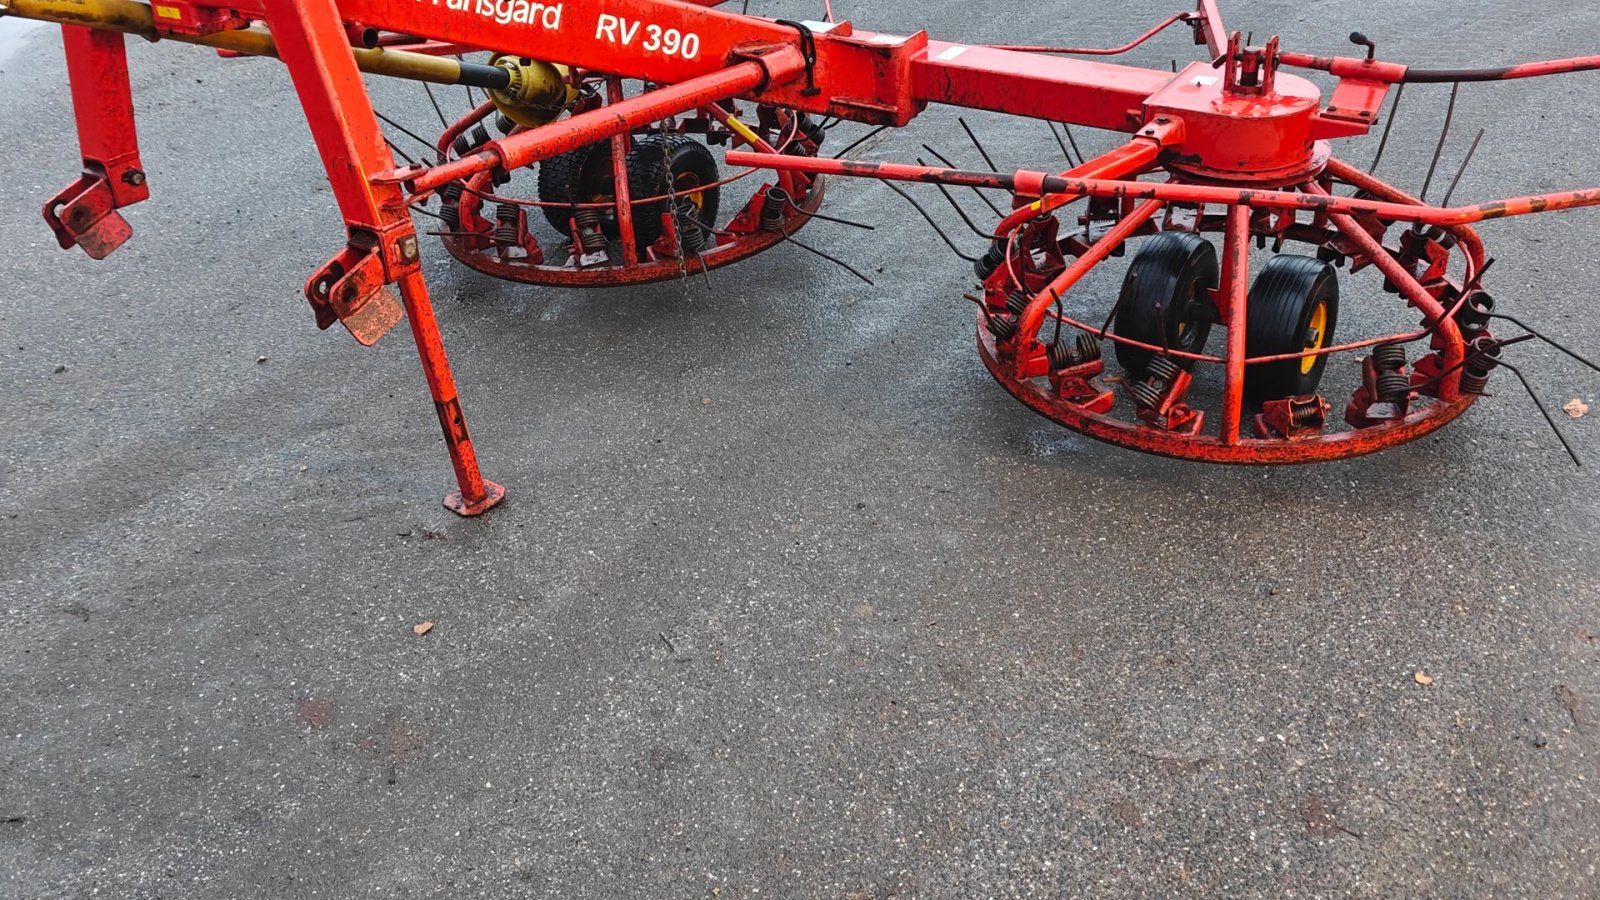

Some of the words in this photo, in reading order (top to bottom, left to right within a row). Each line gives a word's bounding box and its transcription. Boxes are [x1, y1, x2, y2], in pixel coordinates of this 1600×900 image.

[416, 0, 562, 30] nsgard
[595, 13, 640, 46] RV
[643, 24, 700, 60] 390
